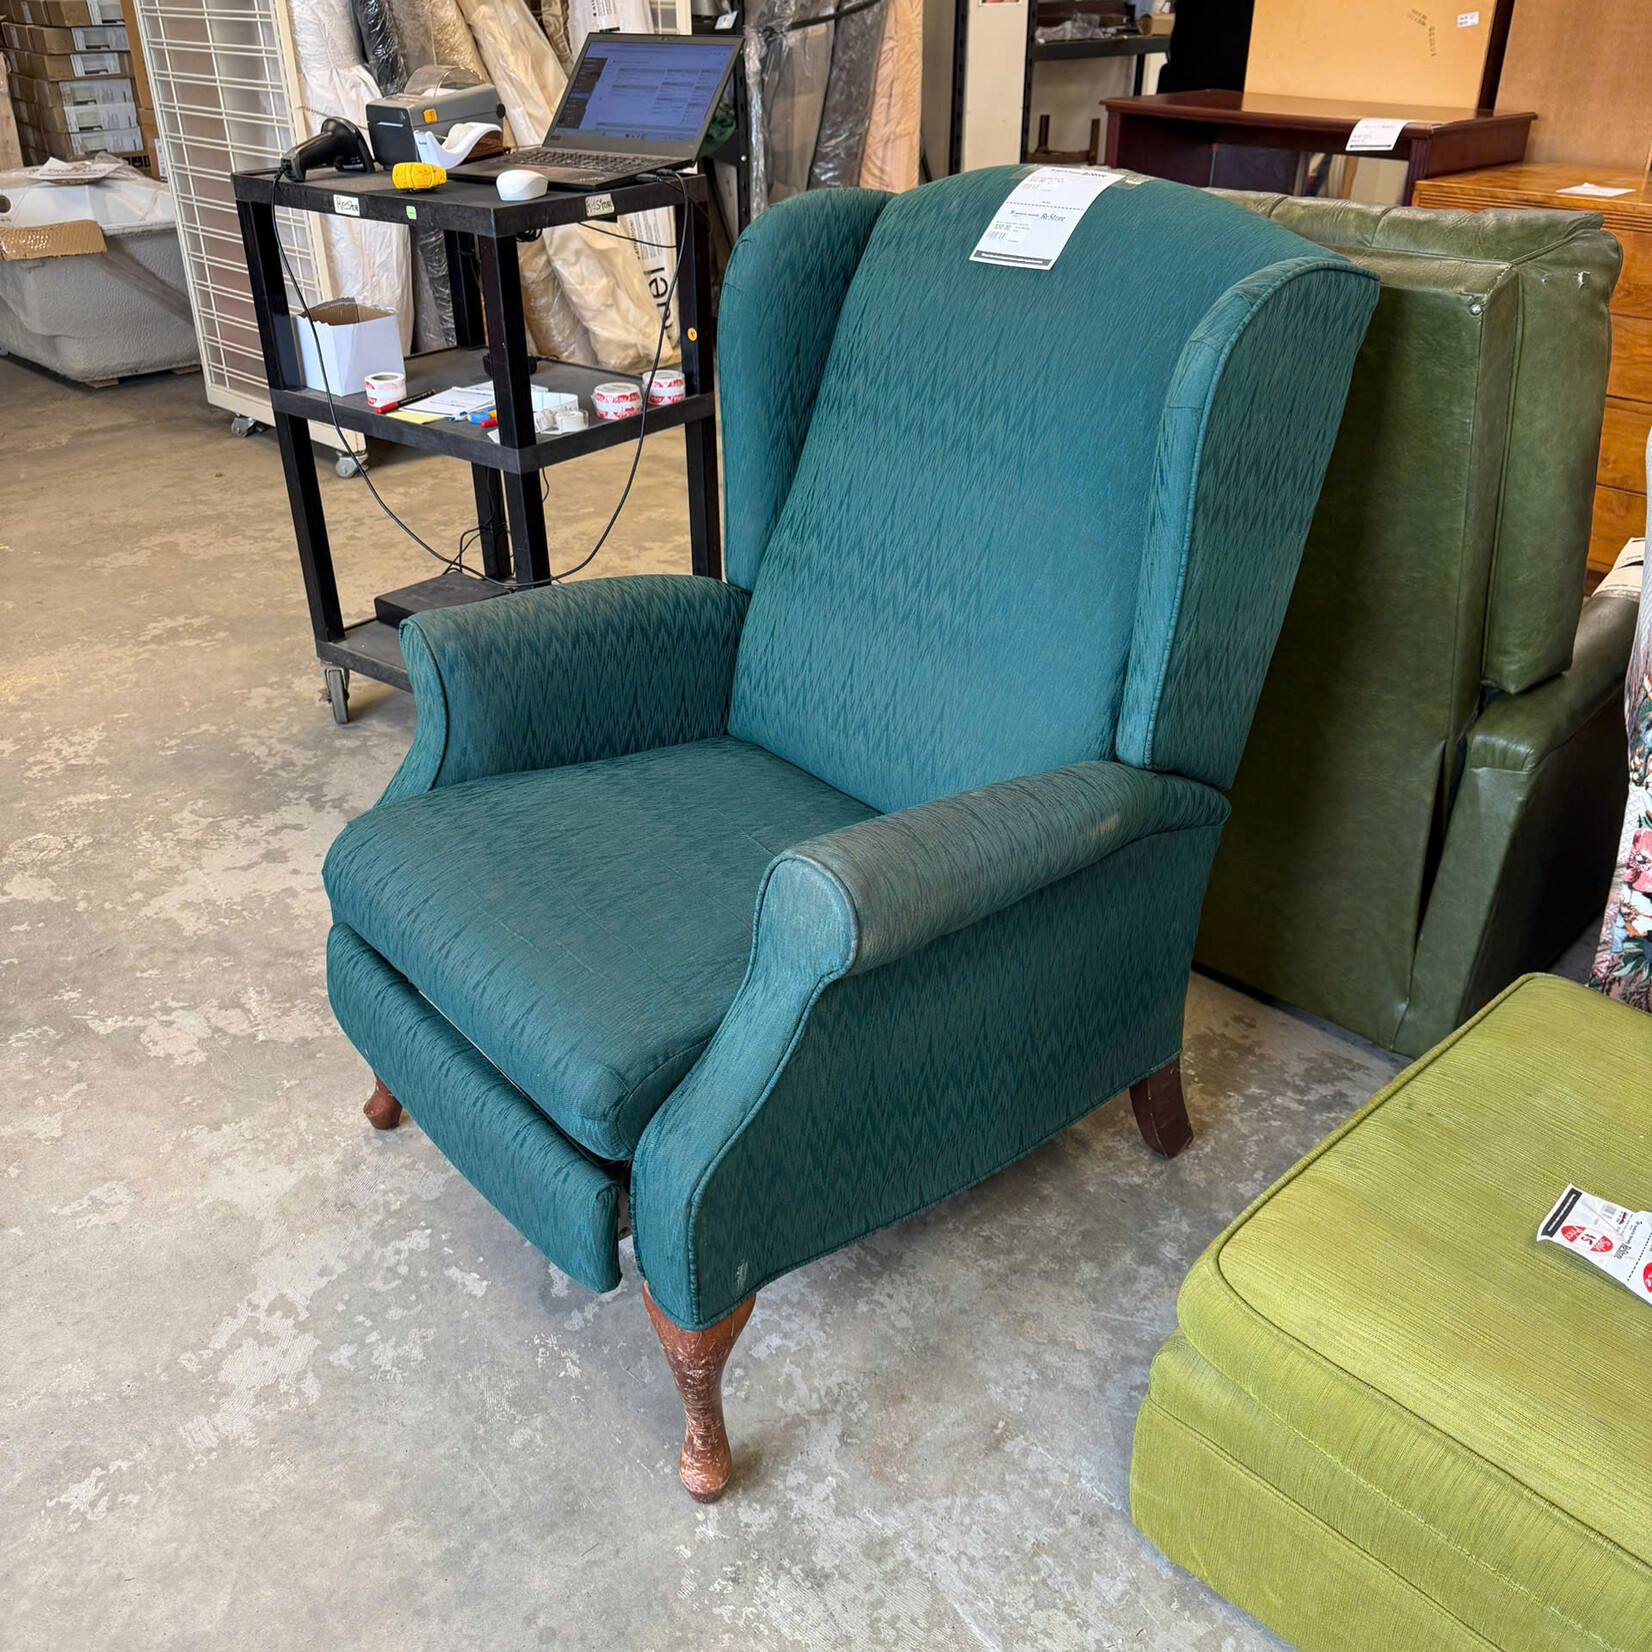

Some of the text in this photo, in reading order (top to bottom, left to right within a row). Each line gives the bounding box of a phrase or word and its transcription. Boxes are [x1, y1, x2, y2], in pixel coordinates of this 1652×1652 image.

[1040, 213, 1066, 222] ReStore
[1565, 1226, 1583, 1240] Price
[1593, 1238, 1612, 1252] Sale
